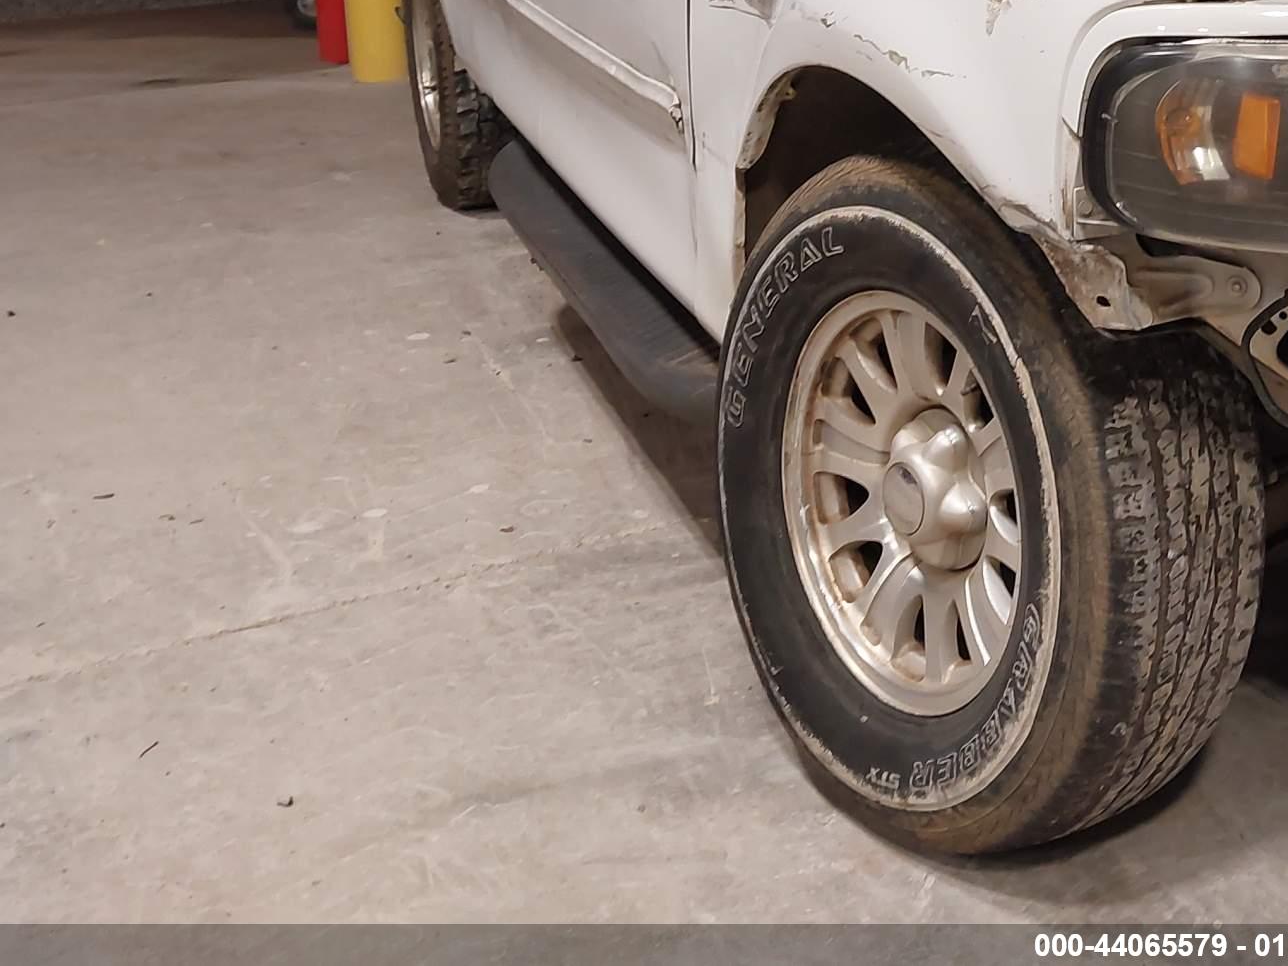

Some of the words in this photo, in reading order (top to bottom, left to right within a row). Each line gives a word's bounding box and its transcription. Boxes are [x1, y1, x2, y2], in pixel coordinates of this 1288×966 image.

[725, 227, 844, 427] GENERAL
[865, 766, 900, 787] STX
[909, 603, 1042, 790] GRABBER
